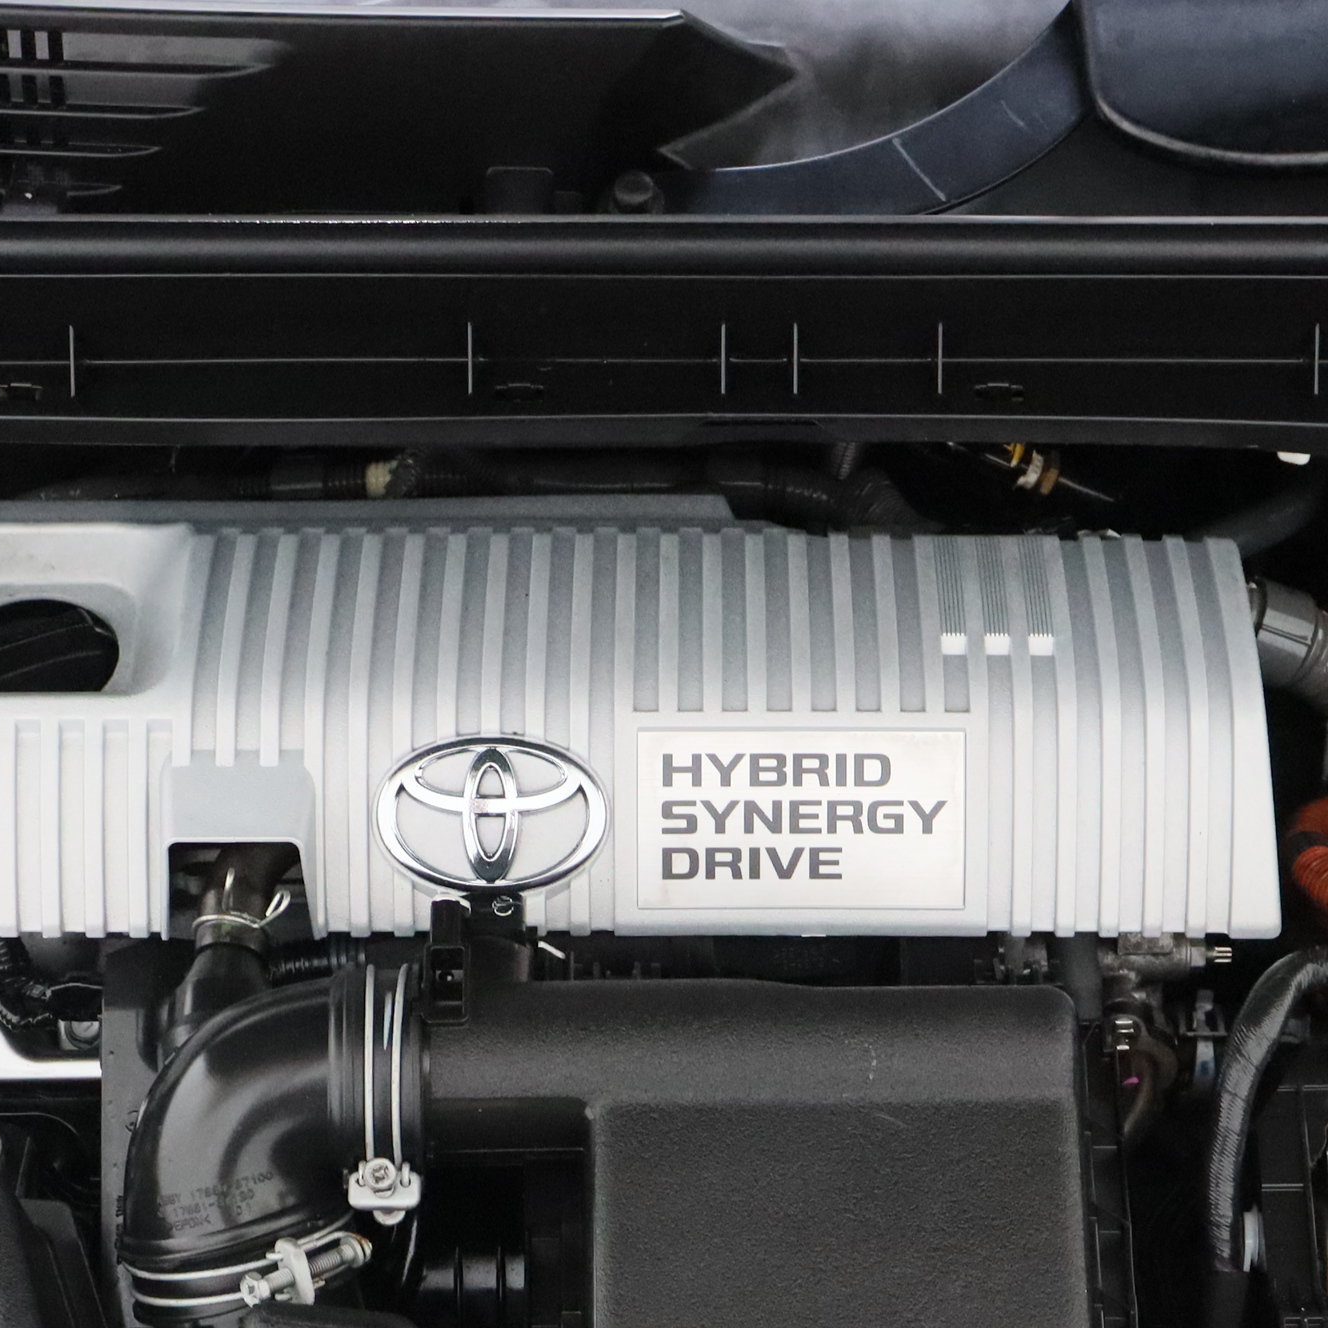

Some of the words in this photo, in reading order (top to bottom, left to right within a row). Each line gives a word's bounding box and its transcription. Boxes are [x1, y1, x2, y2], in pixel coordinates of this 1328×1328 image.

[661, 752, 892, 788] HYBRID
[660, 798, 947, 836] SYNERGY
[661, 845, 844, 881] DRIVE
